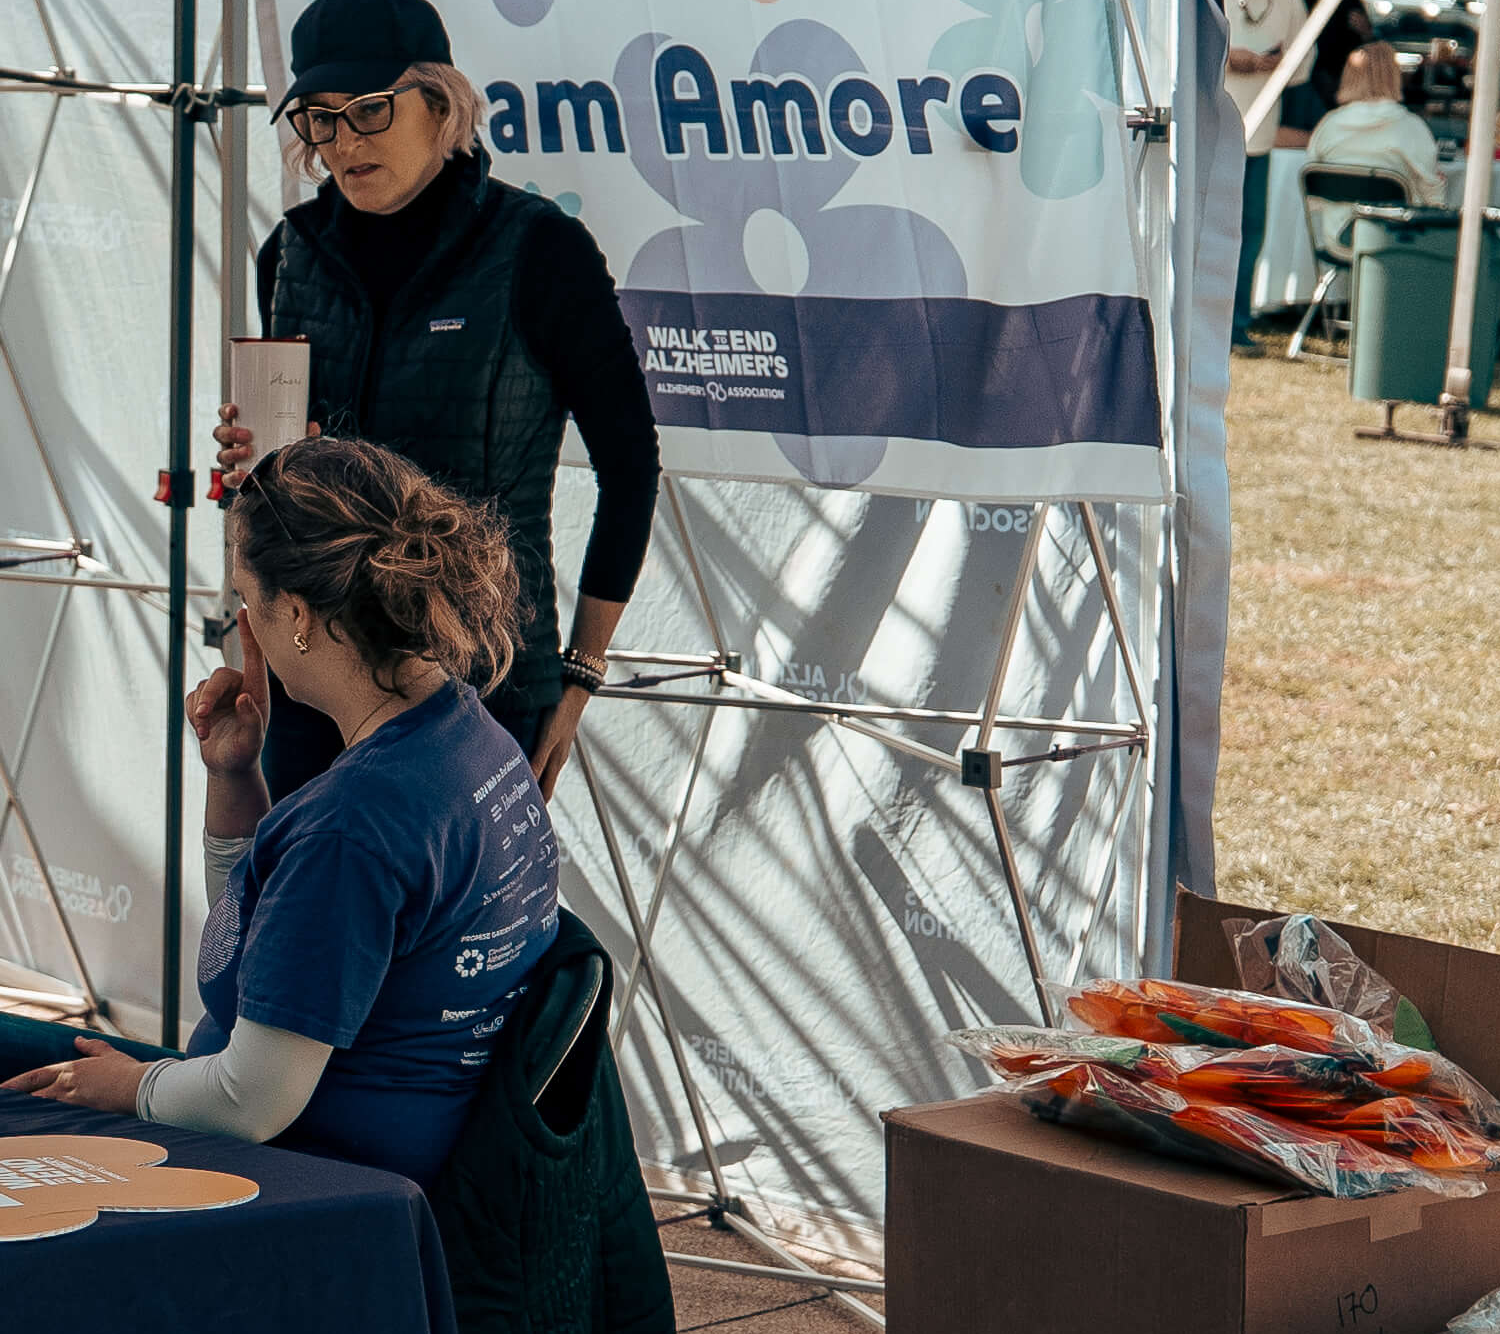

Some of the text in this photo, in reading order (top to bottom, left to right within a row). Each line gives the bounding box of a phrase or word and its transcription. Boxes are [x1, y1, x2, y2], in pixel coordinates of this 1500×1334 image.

[489, 43, 1023, 158] am Amore
[646, 325, 778, 353] WALK TO END
[645, 349, 790, 378] ALZHEIMER'S
[727, 386, 786, 400] ASSOCIATION
[0, 1158, 74, 1179] END
[1336, 1283, 1378, 1327] 170
